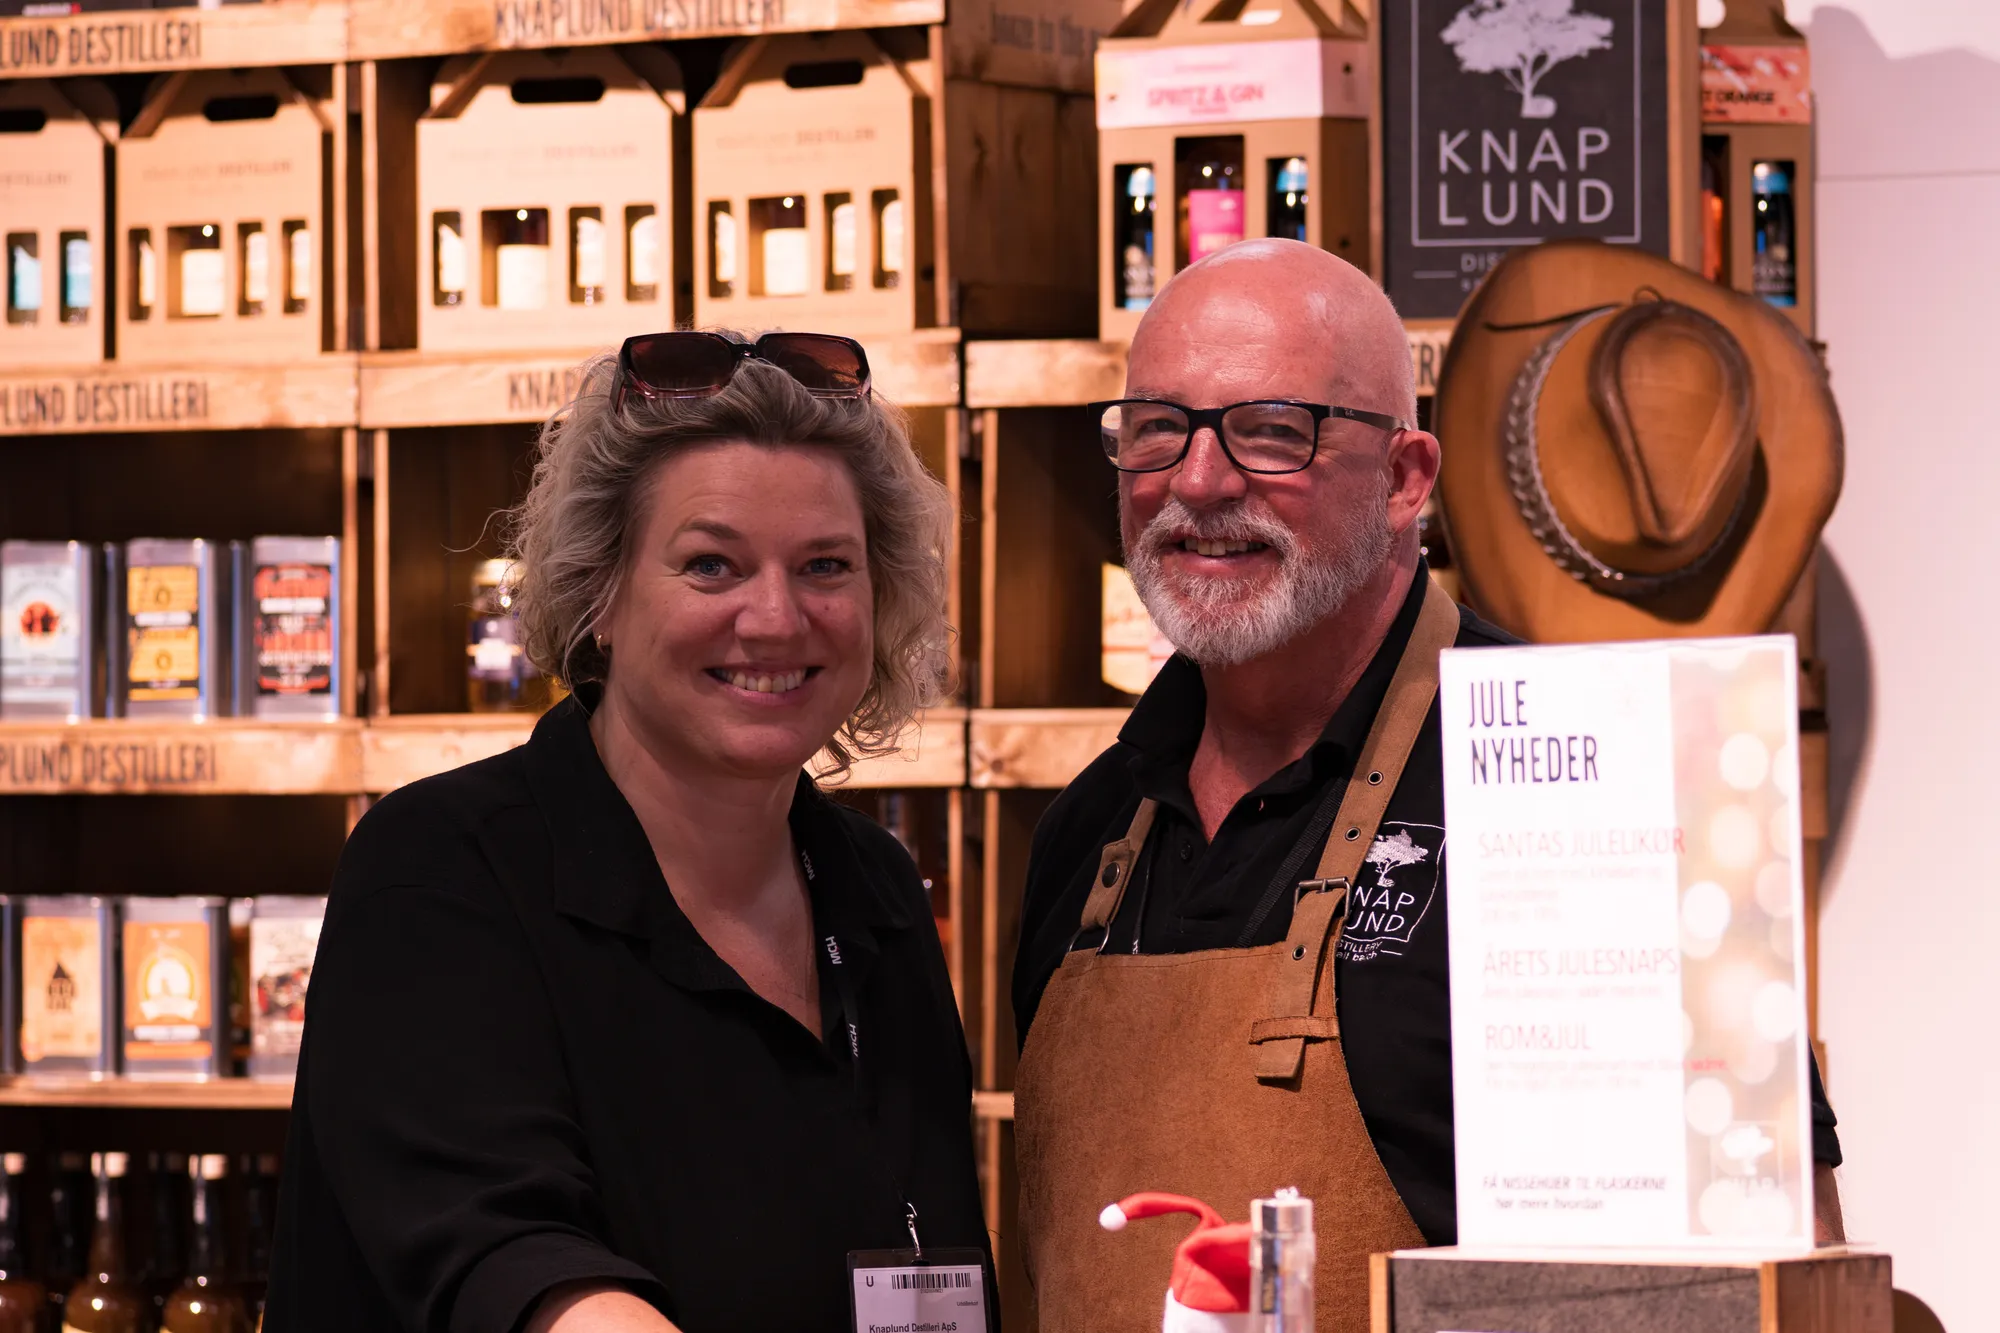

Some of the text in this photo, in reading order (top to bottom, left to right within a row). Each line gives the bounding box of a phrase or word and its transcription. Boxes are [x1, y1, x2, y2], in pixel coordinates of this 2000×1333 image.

[494, 0, 785, 42] KNAPLUND DESTILLERI
[70, 21, 202, 65] DESTILLERI
[1148, 87, 1206, 108] SPRITZ
[1230, 82, 1264, 104] GIN
[1438, 127, 1610, 174] KNAP
[1438, 179, 1614, 227] LUND
[76, 380, 209, 423] DESTILLERI
[1469, 680, 1527, 728] JULE
[81, 740, 216, 784] DESTILLERI
[1471, 735, 1598, 785] NYHEDER
[1479, 829, 1562, 858] SANTAS
[825, 935, 842, 964] MCH
[1482, 943, 1677, 976] ÅRETS JULESNAPS
[1485, 1025, 1592, 1050] ROM&JUL
[866, 1276, 874, 1287] U
[869, 1322, 957, 1333] Knaplund Destilleri ApS
